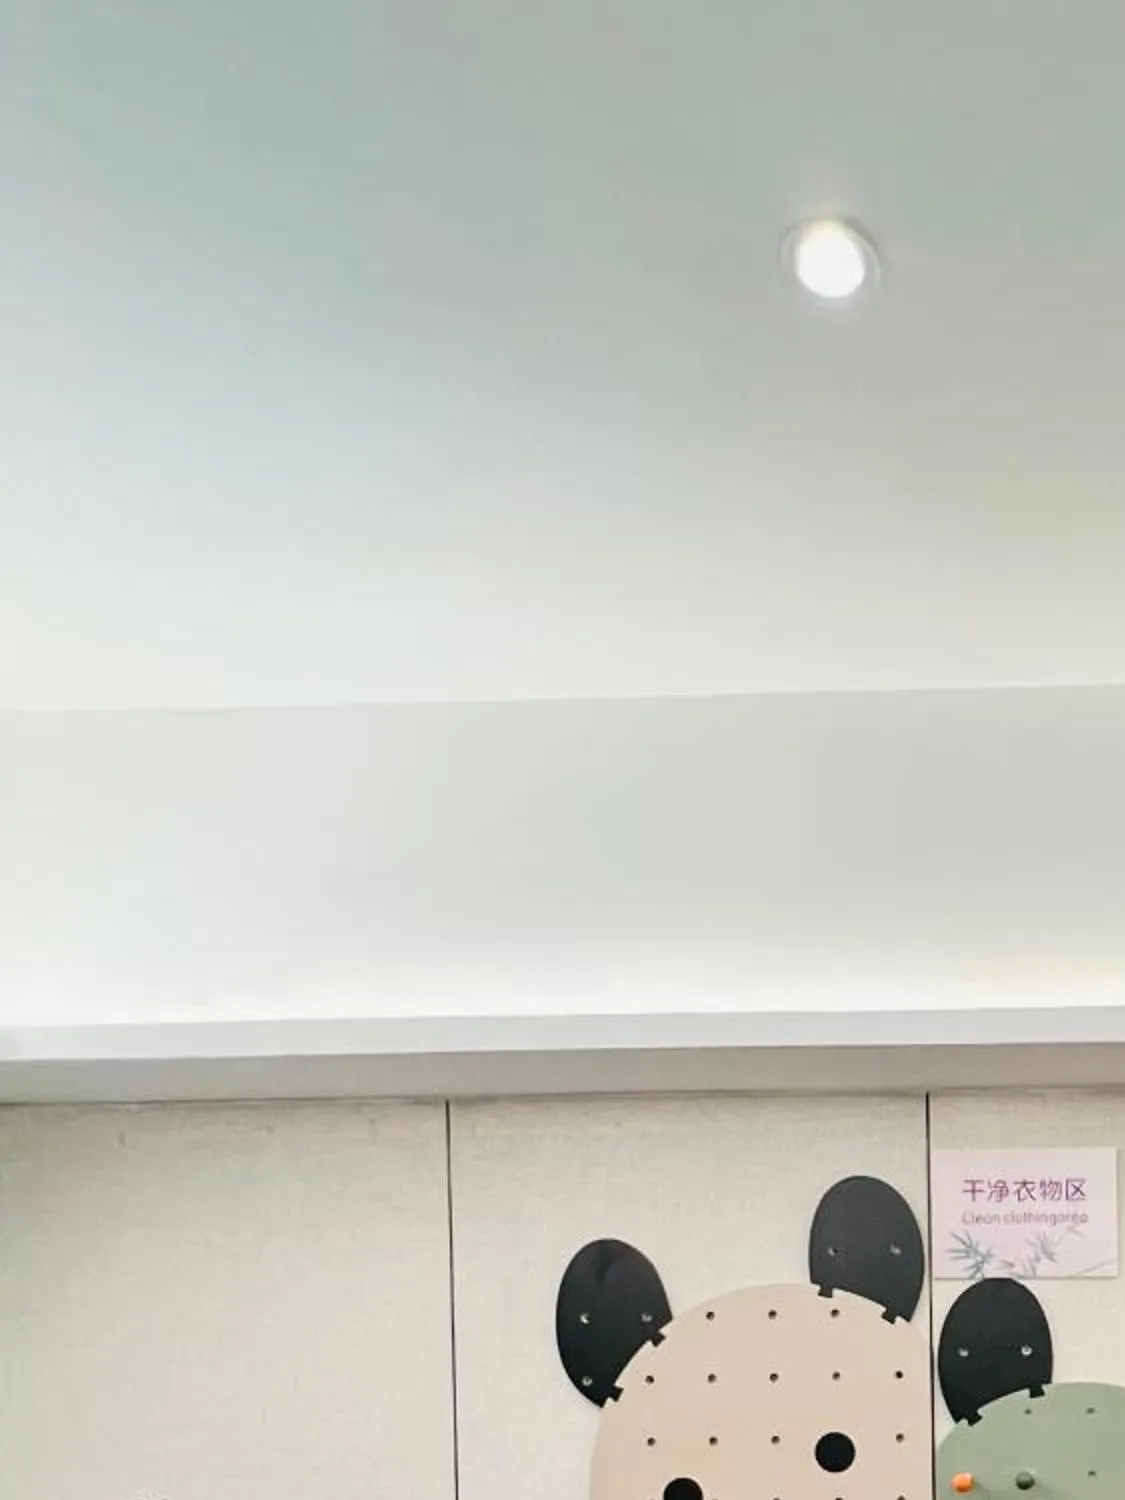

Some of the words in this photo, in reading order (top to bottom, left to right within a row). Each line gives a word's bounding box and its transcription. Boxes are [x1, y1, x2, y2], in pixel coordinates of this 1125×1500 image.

[962, 1178, 1086, 1202] 干净衣物区
[961, 1211, 1000, 1225] Clean
